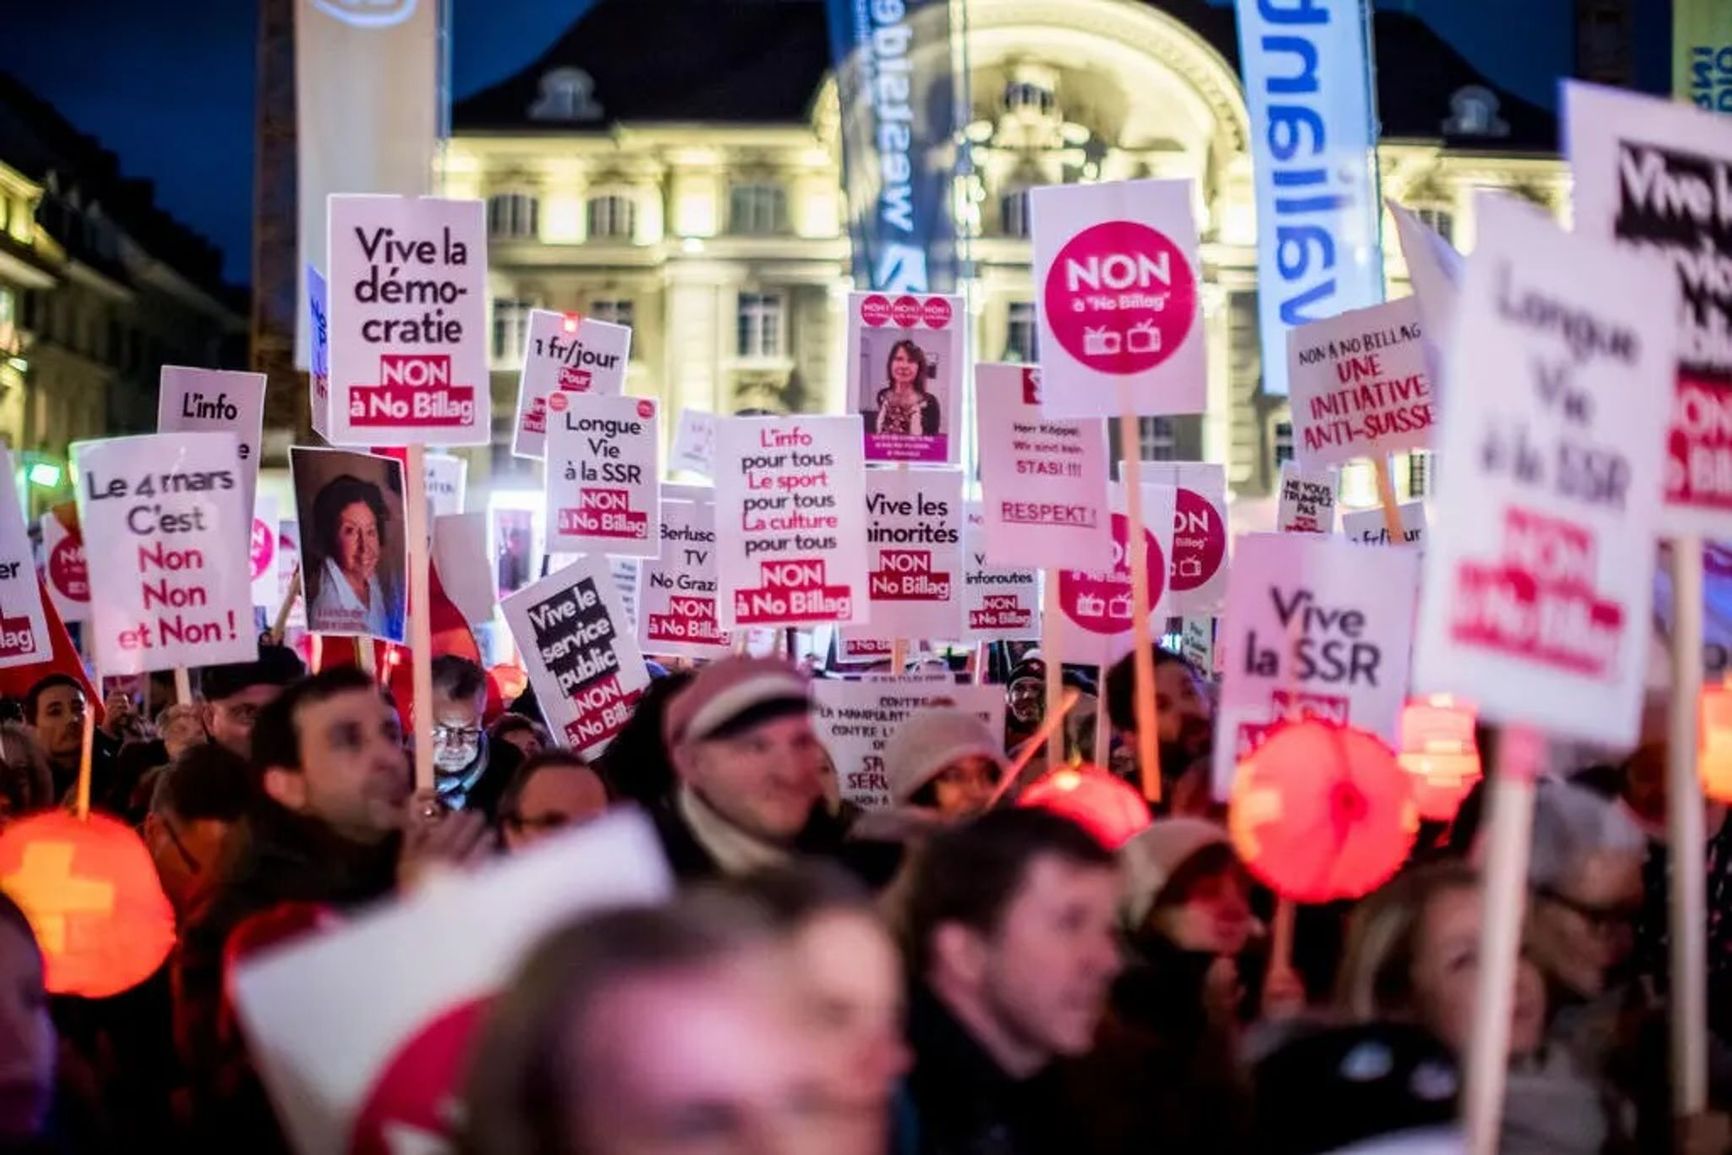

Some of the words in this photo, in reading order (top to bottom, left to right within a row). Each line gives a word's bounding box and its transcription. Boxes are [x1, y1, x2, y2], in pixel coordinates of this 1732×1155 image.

[355, 225, 437, 264] Vive
[443, 225, 468, 265] la
[354, 264, 468, 304] démo-
[1065, 251, 1171, 292] NON
[361, 308, 463, 344] cratie
[548, 335, 620, 370] fr/jour
[1299, 348, 1326, 366] NON
[1339, 338, 1360, 357] NO
[1363, 322, 1422, 353] BILLAG
[382, 359, 450, 386] NON
[1336, 354, 1383, 384] UNE
[182, 391, 238, 420] L'info
[350, 391, 366, 418] à
[370, 392, 409, 419] No
[413, 391, 474, 425] Billag
[1310, 373, 1430, 420] INITIATIVE
[566, 412, 643, 439] Longue
[761, 426, 813, 449] L'info
[587, 437, 621, 460] Vie
[741, 454, 785, 475] pour
[791, 449, 834, 467] tous
[565, 460, 577, 481] à
[581, 462, 598, 482] la
[602, 464, 642, 486] SSR
[748, 471, 772, 490] Le
[777, 470, 828, 492] sport
[1016, 459, 1064, 476] STASI
[87, 471, 127, 501] Le
[135, 474, 155, 498] 4
[161, 470, 234, 494] mars
[582, 491, 627, 511] NON
[743, 497, 787, 516] pour
[793, 492, 836, 509] tous
[866, 493, 913, 516] Vive
[918, 492, 949, 516] les
[1001, 501, 1086, 523] RESPEKT
[127, 504, 206, 536] C'est
[573, 512, 598, 531] No
[601, 513, 648, 539] Billag
[742, 511, 766, 532] La
[770, 508, 839, 530] culture
[137, 541, 204, 573] Non
[684, 549, 709, 566] TV
[744, 538, 789, 558] pour
[794, 534, 838, 552] tous
[762, 562, 822, 588] NON
[880, 554, 929, 573] NON
[650, 572, 674, 590] No
[872, 577, 899, 595] No
[902, 576, 950, 599] Billag
[966, 570, 1033, 586] inforoutes
[141, 578, 206, 611] Non
[670, 598, 714, 617] NON
[753, 592, 786, 616] No
[789, 586, 852, 620] Billag
[984, 597, 1017, 610] NON
[529, 599, 577, 632] Vive
[573, 585, 597, 611] le
[1269, 586, 1365, 639] Vive
[118, 623, 153, 650] et
[158, 615, 222, 648] Non
[227, 610, 237, 641] !
[541, 617, 611, 664] service
[660, 619, 686, 638] No
[1244, 630, 1279, 677] la
[1294, 638, 1382, 688] SSR
[558, 646, 619, 700] public
[575, 679, 621, 716] NON
[577, 719, 604, 742] No
